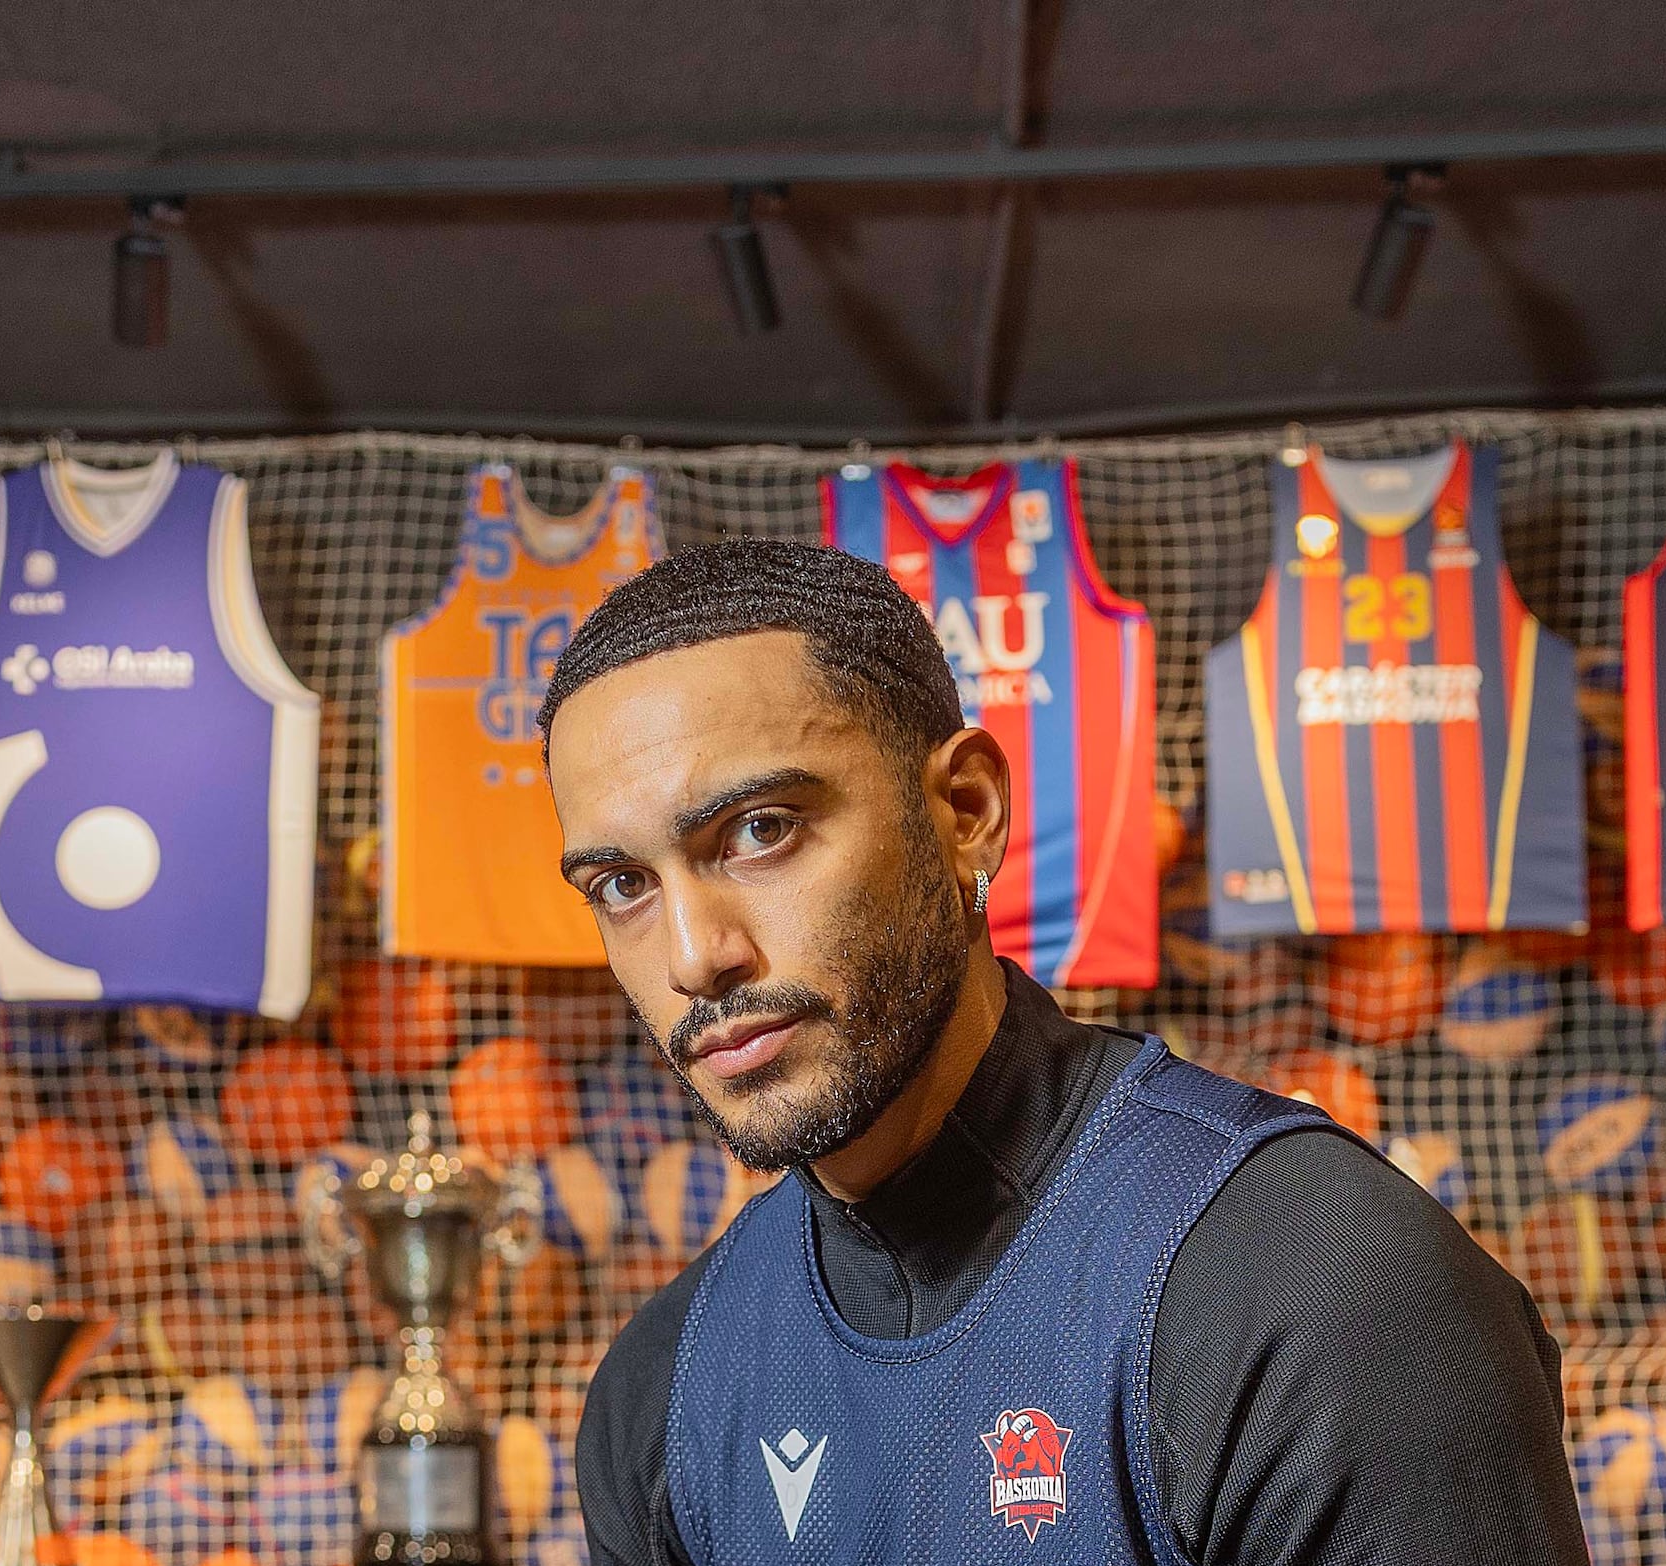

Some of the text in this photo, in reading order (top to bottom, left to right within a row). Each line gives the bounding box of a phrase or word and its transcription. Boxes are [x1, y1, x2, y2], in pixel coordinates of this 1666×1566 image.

[918, 592, 1051, 674] AU
[1343, 572, 1431, 643] 23
[480, 608, 573, 685] TA
[994, 1475, 1063, 1508] BASKONIA
